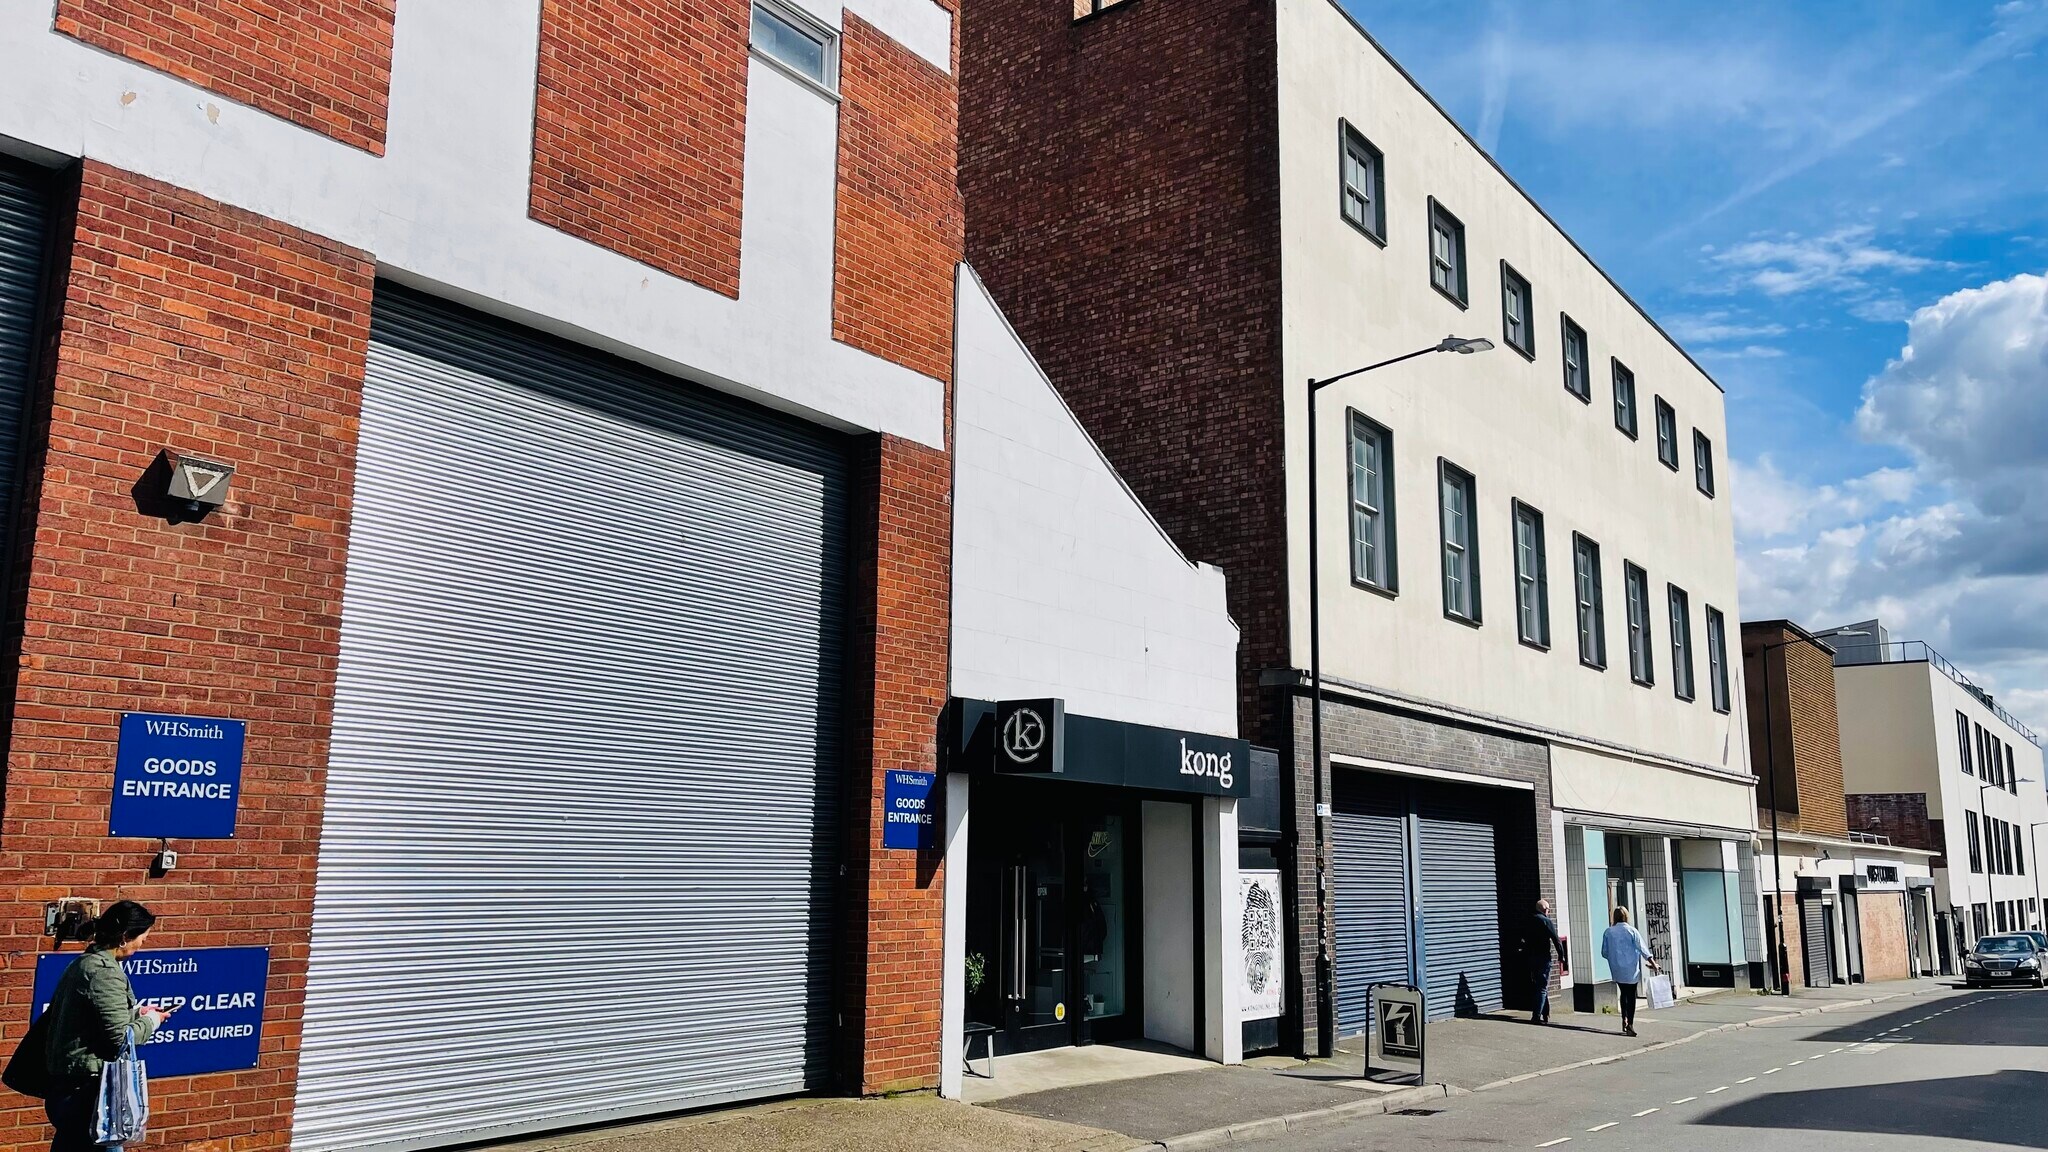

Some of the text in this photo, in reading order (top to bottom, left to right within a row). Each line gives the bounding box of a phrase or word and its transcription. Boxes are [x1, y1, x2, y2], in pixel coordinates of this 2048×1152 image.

[145, 720, 224, 739] WHSmith
[144, 758, 217, 776] GOODS
[1179, 737, 1234, 789] kong
[895, 774, 928, 786] WHSmith
[122, 780, 232, 799] ENTRANCE
[896, 798, 926, 809] GOODS
[888, 812, 932, 824] ENTRANCE
[119, 957, 198, 975] WHSmith
[191, 992, 256, 1011] CLEAR
[178, 1024, 253, 1042] REQUIRED
